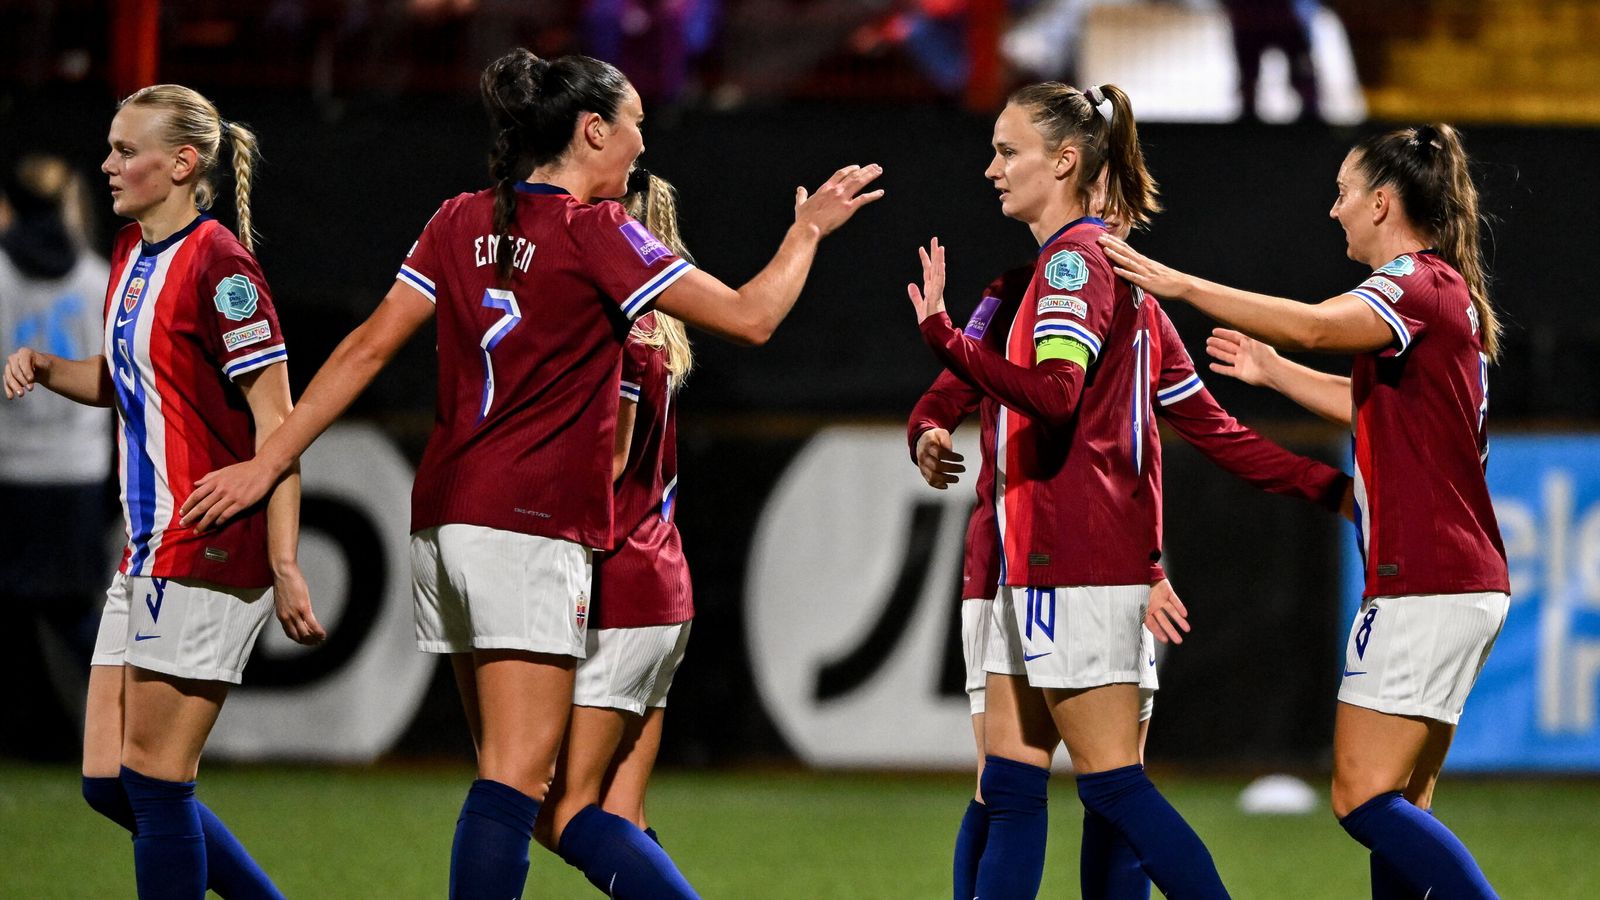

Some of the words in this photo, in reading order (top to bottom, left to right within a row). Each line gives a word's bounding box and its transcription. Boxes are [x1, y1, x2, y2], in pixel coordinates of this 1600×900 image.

[474, 234, 536, 273] ENEN
[474, 287, 522, 428] 7
[1025, 585, 1056, 643] 10
[1355, 608, 1378, 661] 8
